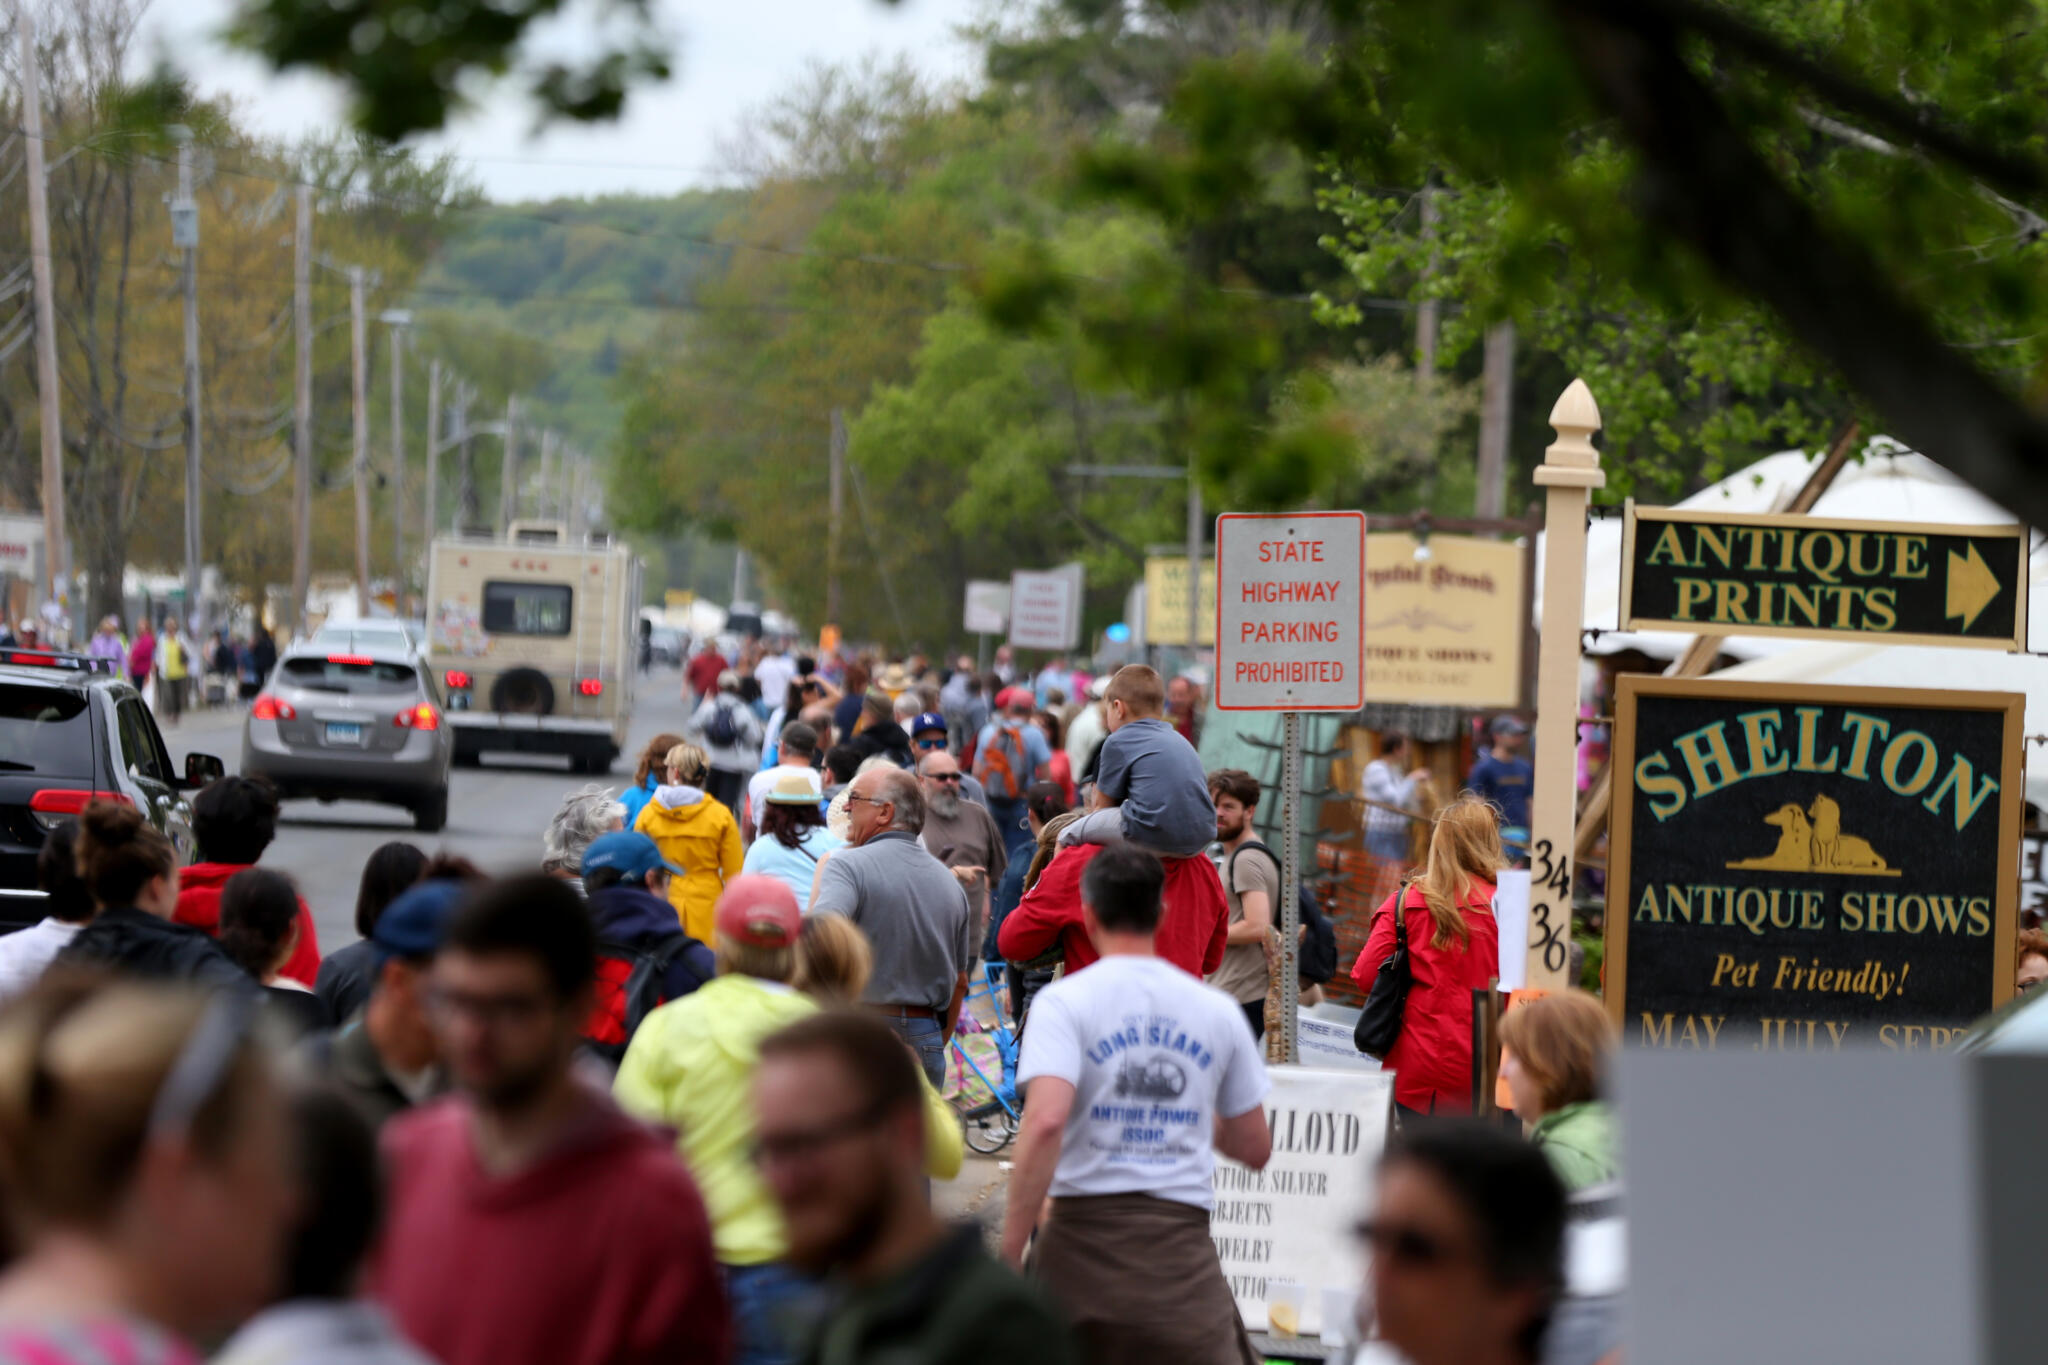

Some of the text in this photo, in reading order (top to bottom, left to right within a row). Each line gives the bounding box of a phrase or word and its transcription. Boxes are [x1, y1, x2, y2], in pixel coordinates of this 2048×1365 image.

[1258, 541, 1325, 563] STATE
[1647, 524, 1929, 582] ANTIQUE
[1241, 581, 1342, 603] HIGHWAY
[1673, 578, 1897, 631] PRINTS
[1241, 621, 1339, 643] PARKING
[1235, 661, 1344, 683] PROHIBITED
[1634, 707, 2000, 832] SHELTON
[1531, 839, 1570, 901] 34
[1635, 884, 1991, 937] ANTIQUE SHOWS
[1529, 903, 1566, 972] 36
[1711, 953, 1910, 1001] Pet Friendly!
[1640, 1012, 1726, 1051] MAY
[1752, 1017, 1849, 1053] JULY
[1212, 1167, 1328, 1196] NTIQUE SILVER
